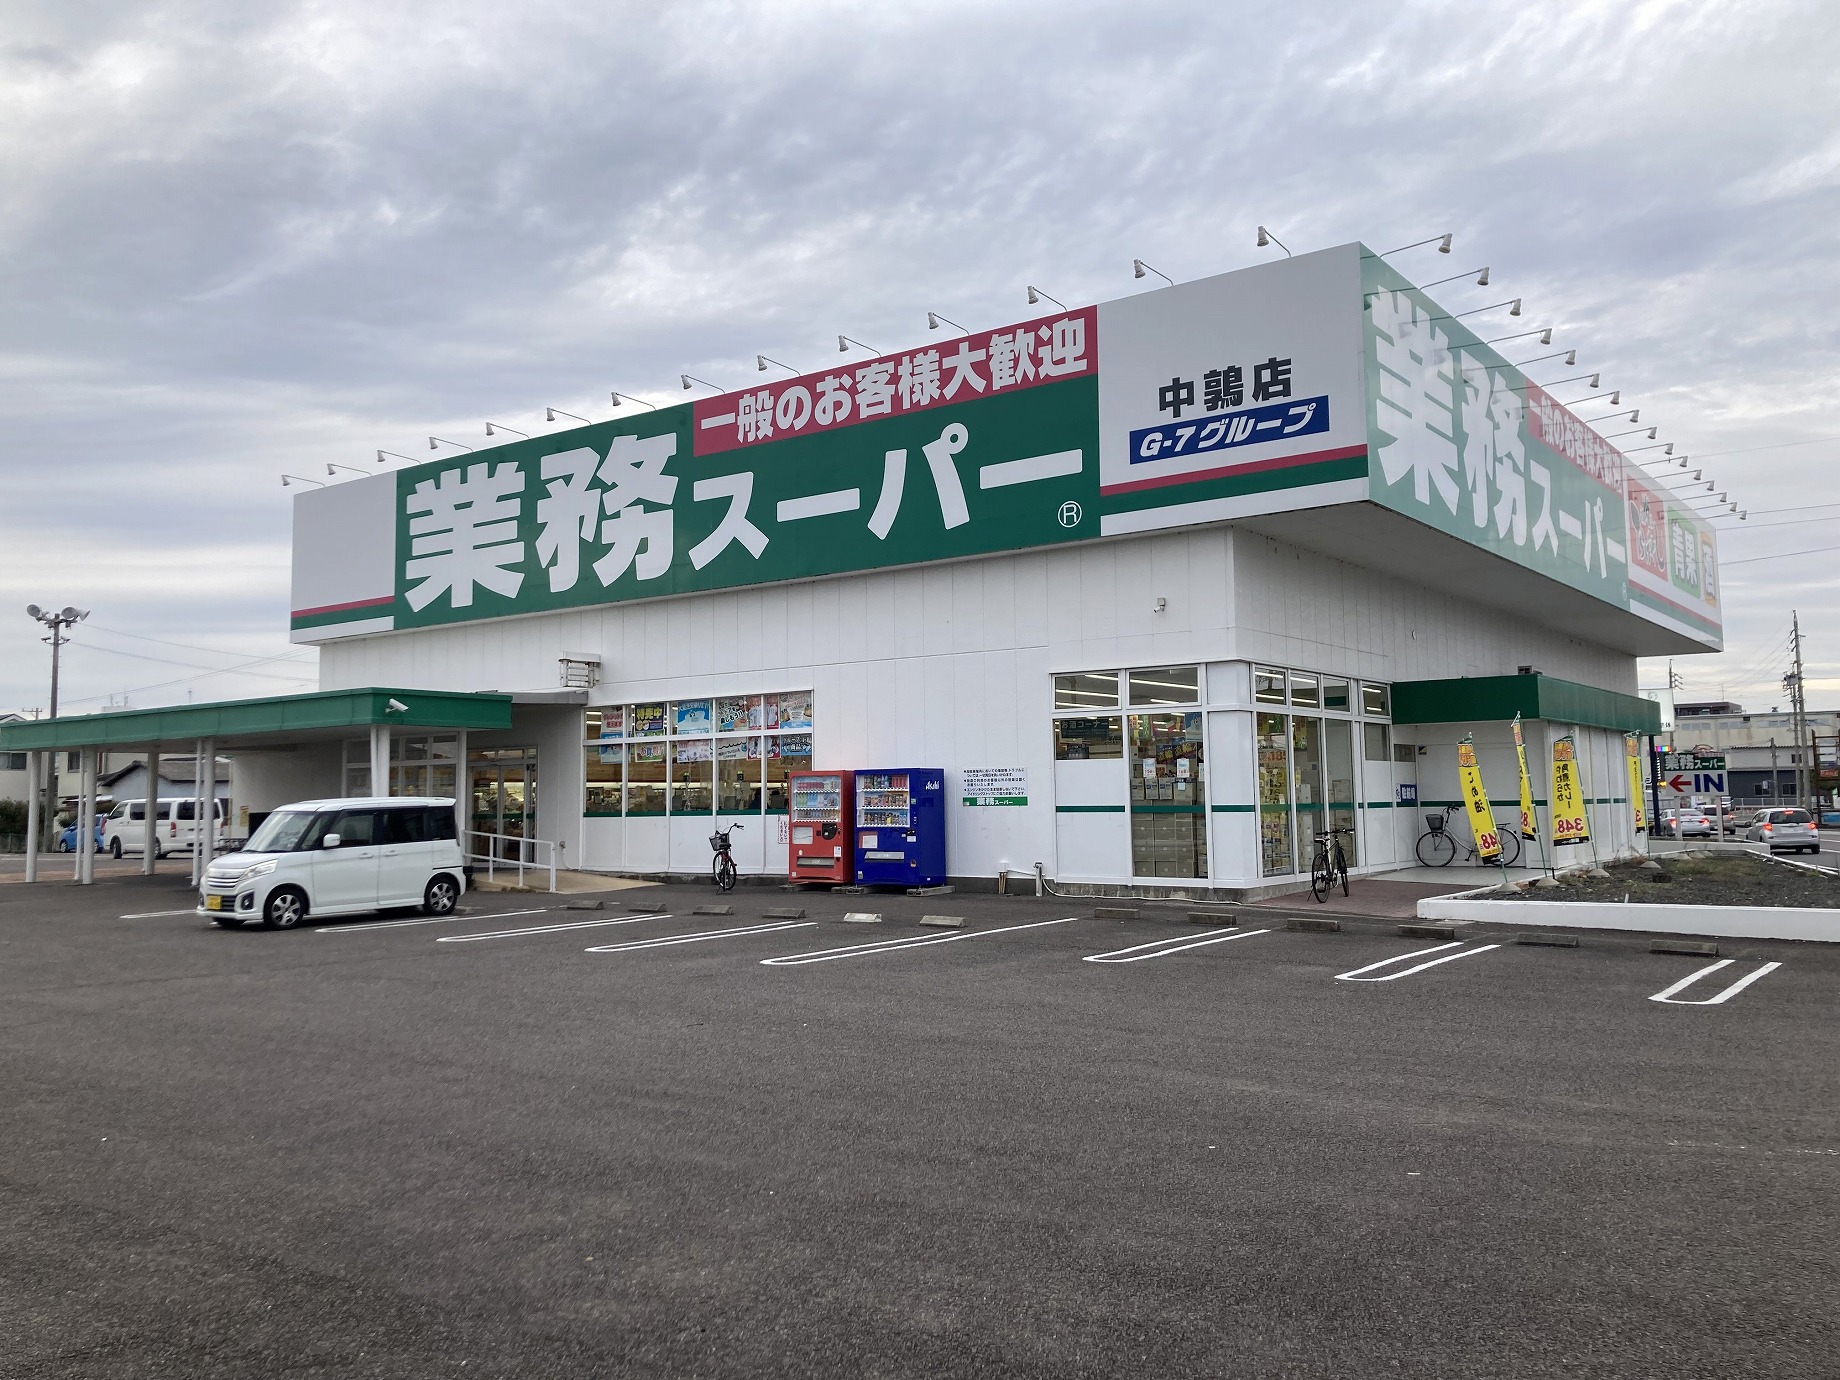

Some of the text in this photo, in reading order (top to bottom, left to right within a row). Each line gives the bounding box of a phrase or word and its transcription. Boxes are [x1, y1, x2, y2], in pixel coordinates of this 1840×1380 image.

[701, 317, 1089, 444] 一般のお客様大歓迎
[1158, 357, 1292, 419] 中鶉店
[1140, 402, 1317, 457] G-7グループ
[1371, 285, 1626, 579] 業務スーパー
[404, 422, 1083, 612] 業務スーパー
[1062, 719, 1108, 729] お酒コーナー
[1664, 754, 1725, 770] 業務スーパー
[1694, 773, 1725, 793] IN
